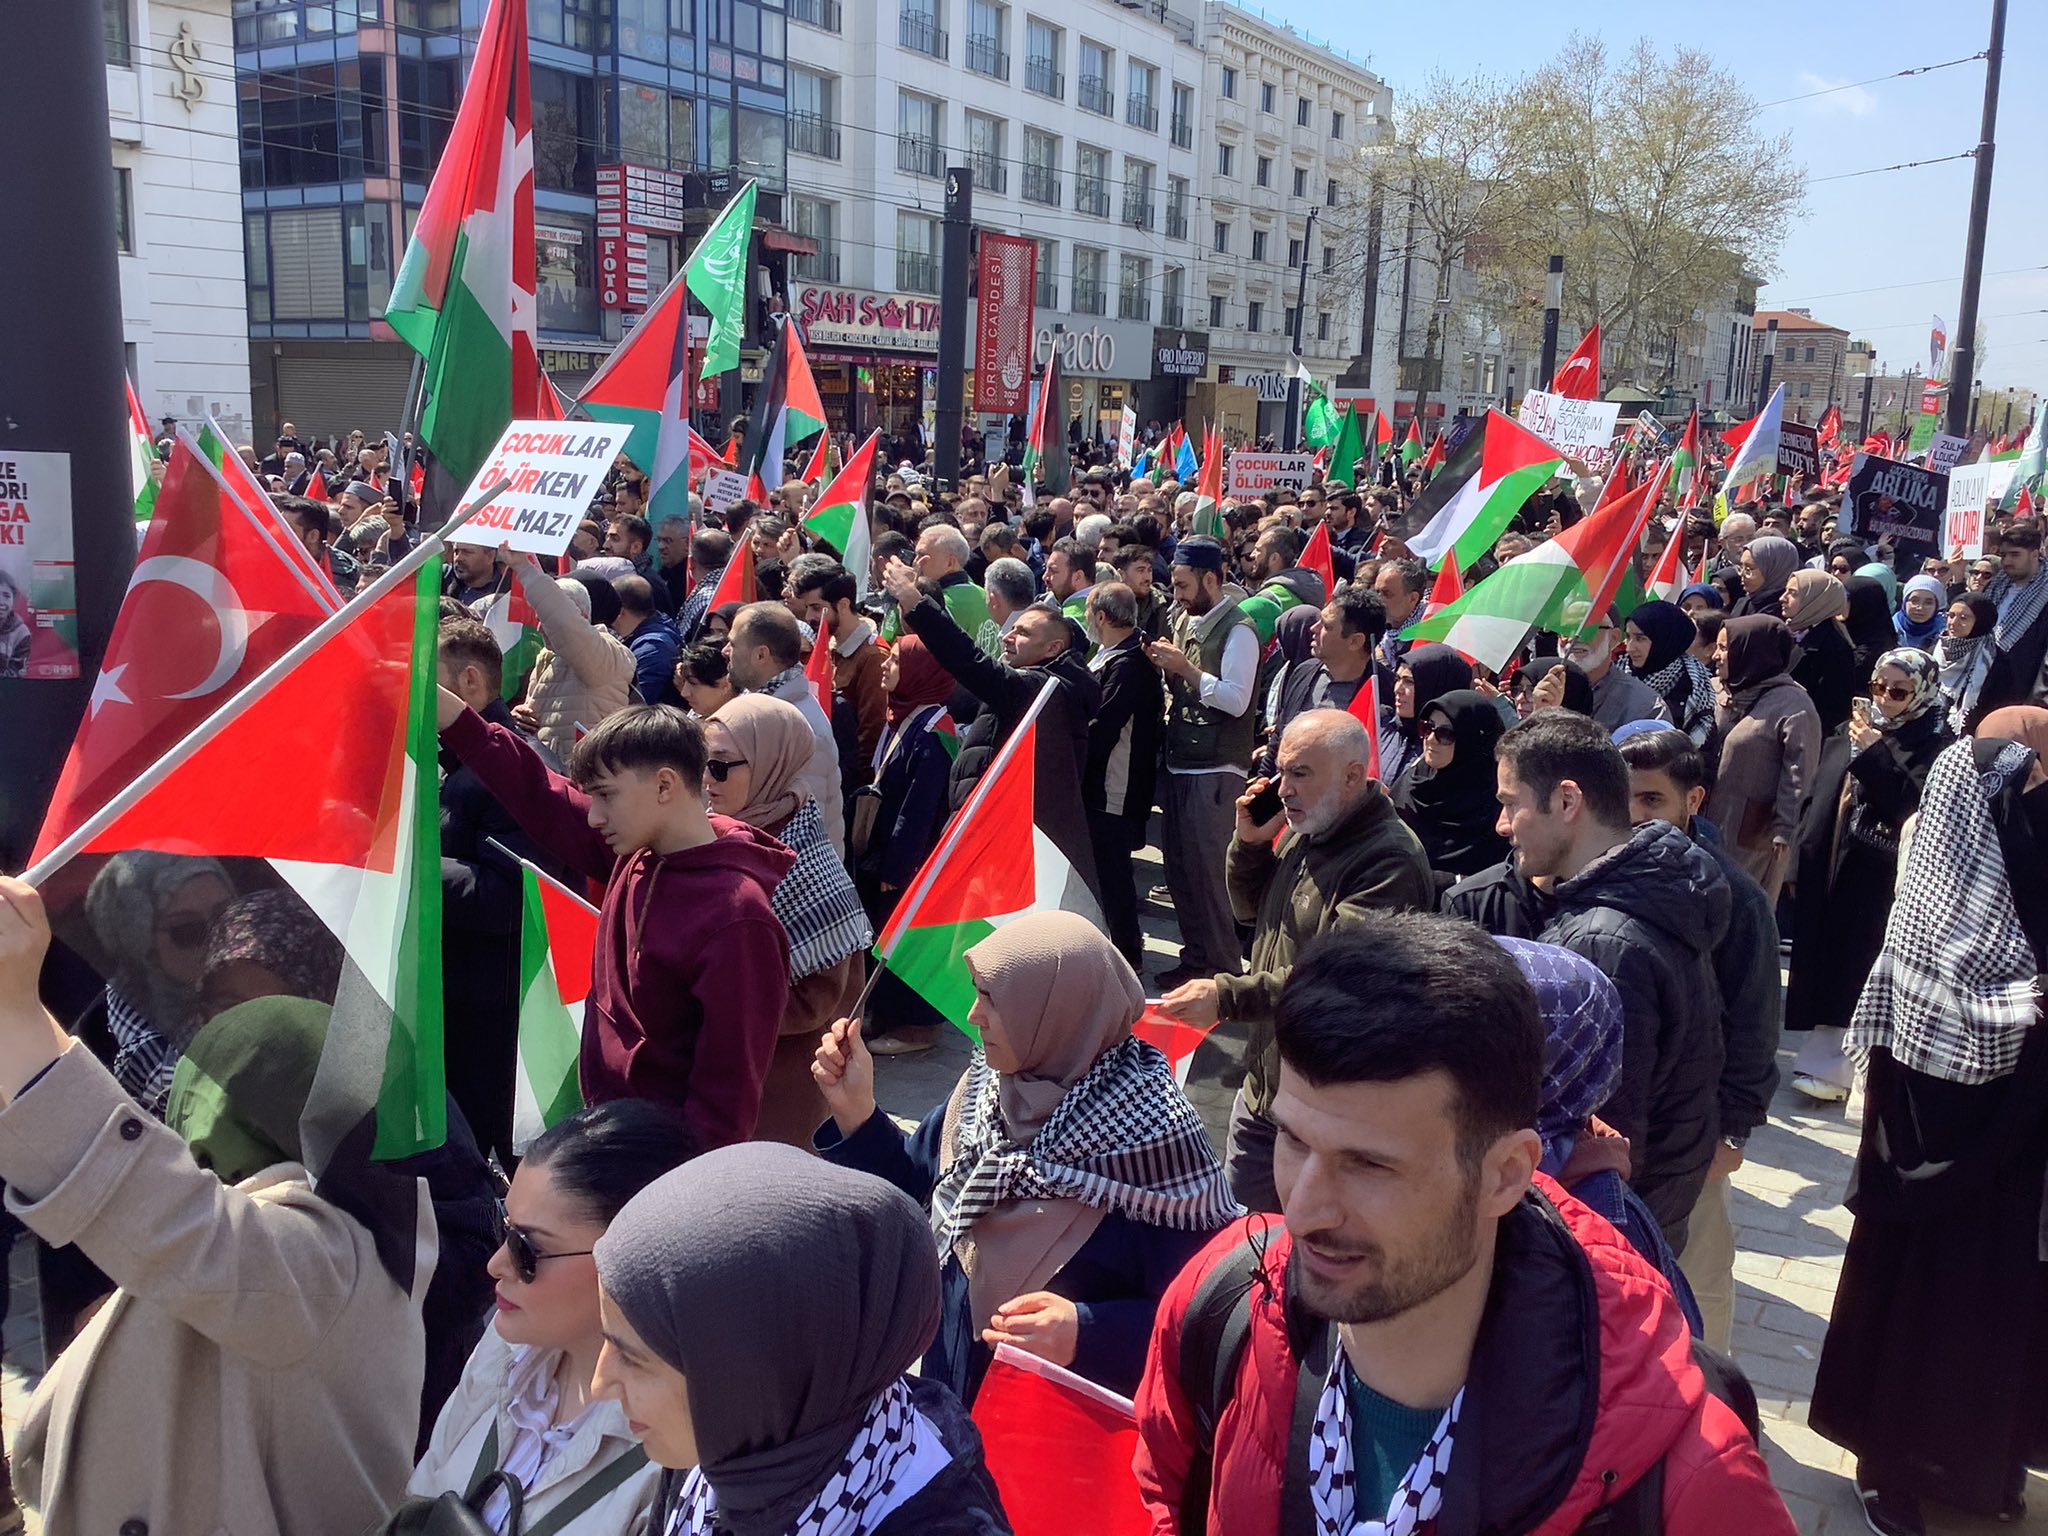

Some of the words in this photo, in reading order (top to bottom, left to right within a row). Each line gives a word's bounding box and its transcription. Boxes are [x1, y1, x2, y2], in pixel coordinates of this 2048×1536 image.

[603, 241, 618, 304] FOTO
[543, 351, 589, 373] EMRE
[1159, 348, 1175, 363] ORO
[1175, 349, 1205, 366] IMPERIO
[986, 351, 998, 397] ORDU
[1004, 390, 1019, 399] 2023
[501, 432, 612, 459] ÇOCUKLAR
[1563, 428, 1587, 444] VAR
[1235, 459, 1306, 473] ÇOCUKLAR
[1235, 474, 1303, 490] ÖLÜRKEN
[1870, 470, 1938, 510] ABLUKA
[1948, 510, 1981, 546] KALDIR!
